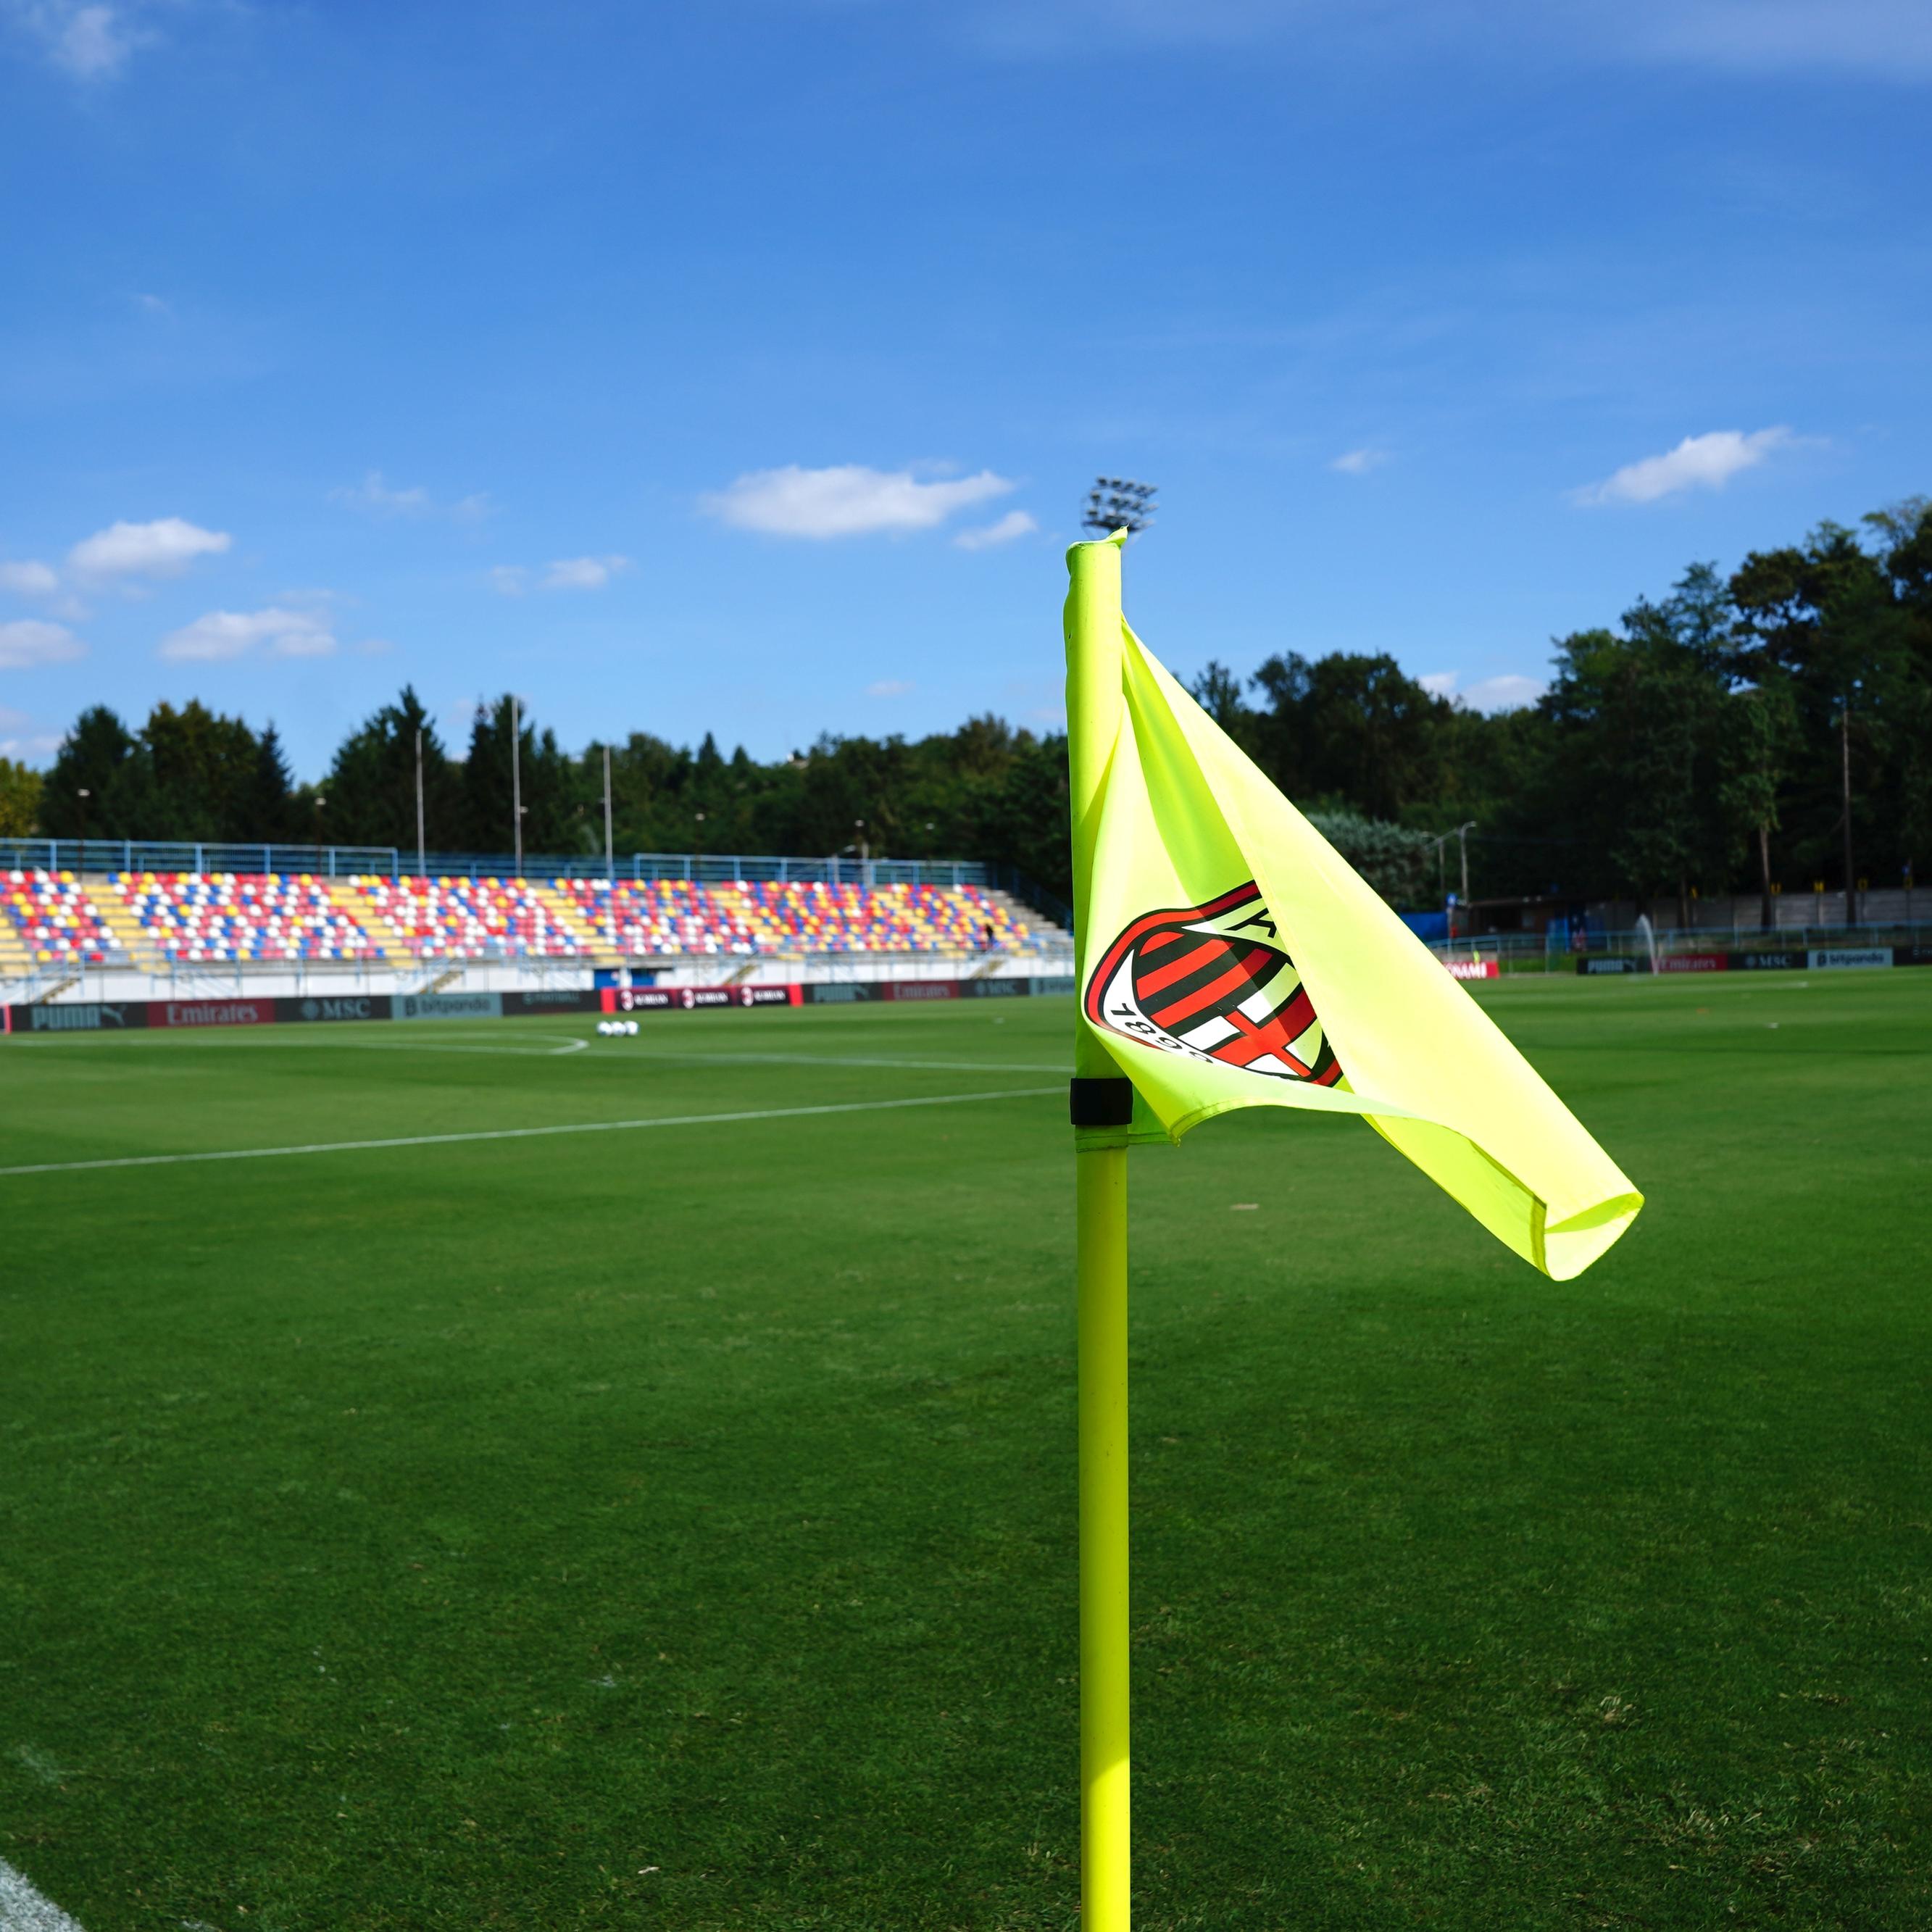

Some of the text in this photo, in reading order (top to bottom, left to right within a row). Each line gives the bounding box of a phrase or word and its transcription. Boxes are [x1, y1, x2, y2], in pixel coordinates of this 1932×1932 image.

[31, 1005, 101, 1028] PUMA
[167, 1003, 258, 1025] Emirates
[322, 997, 370, 1020] MSC
[420, 996, 491, 1017] bitpanda
